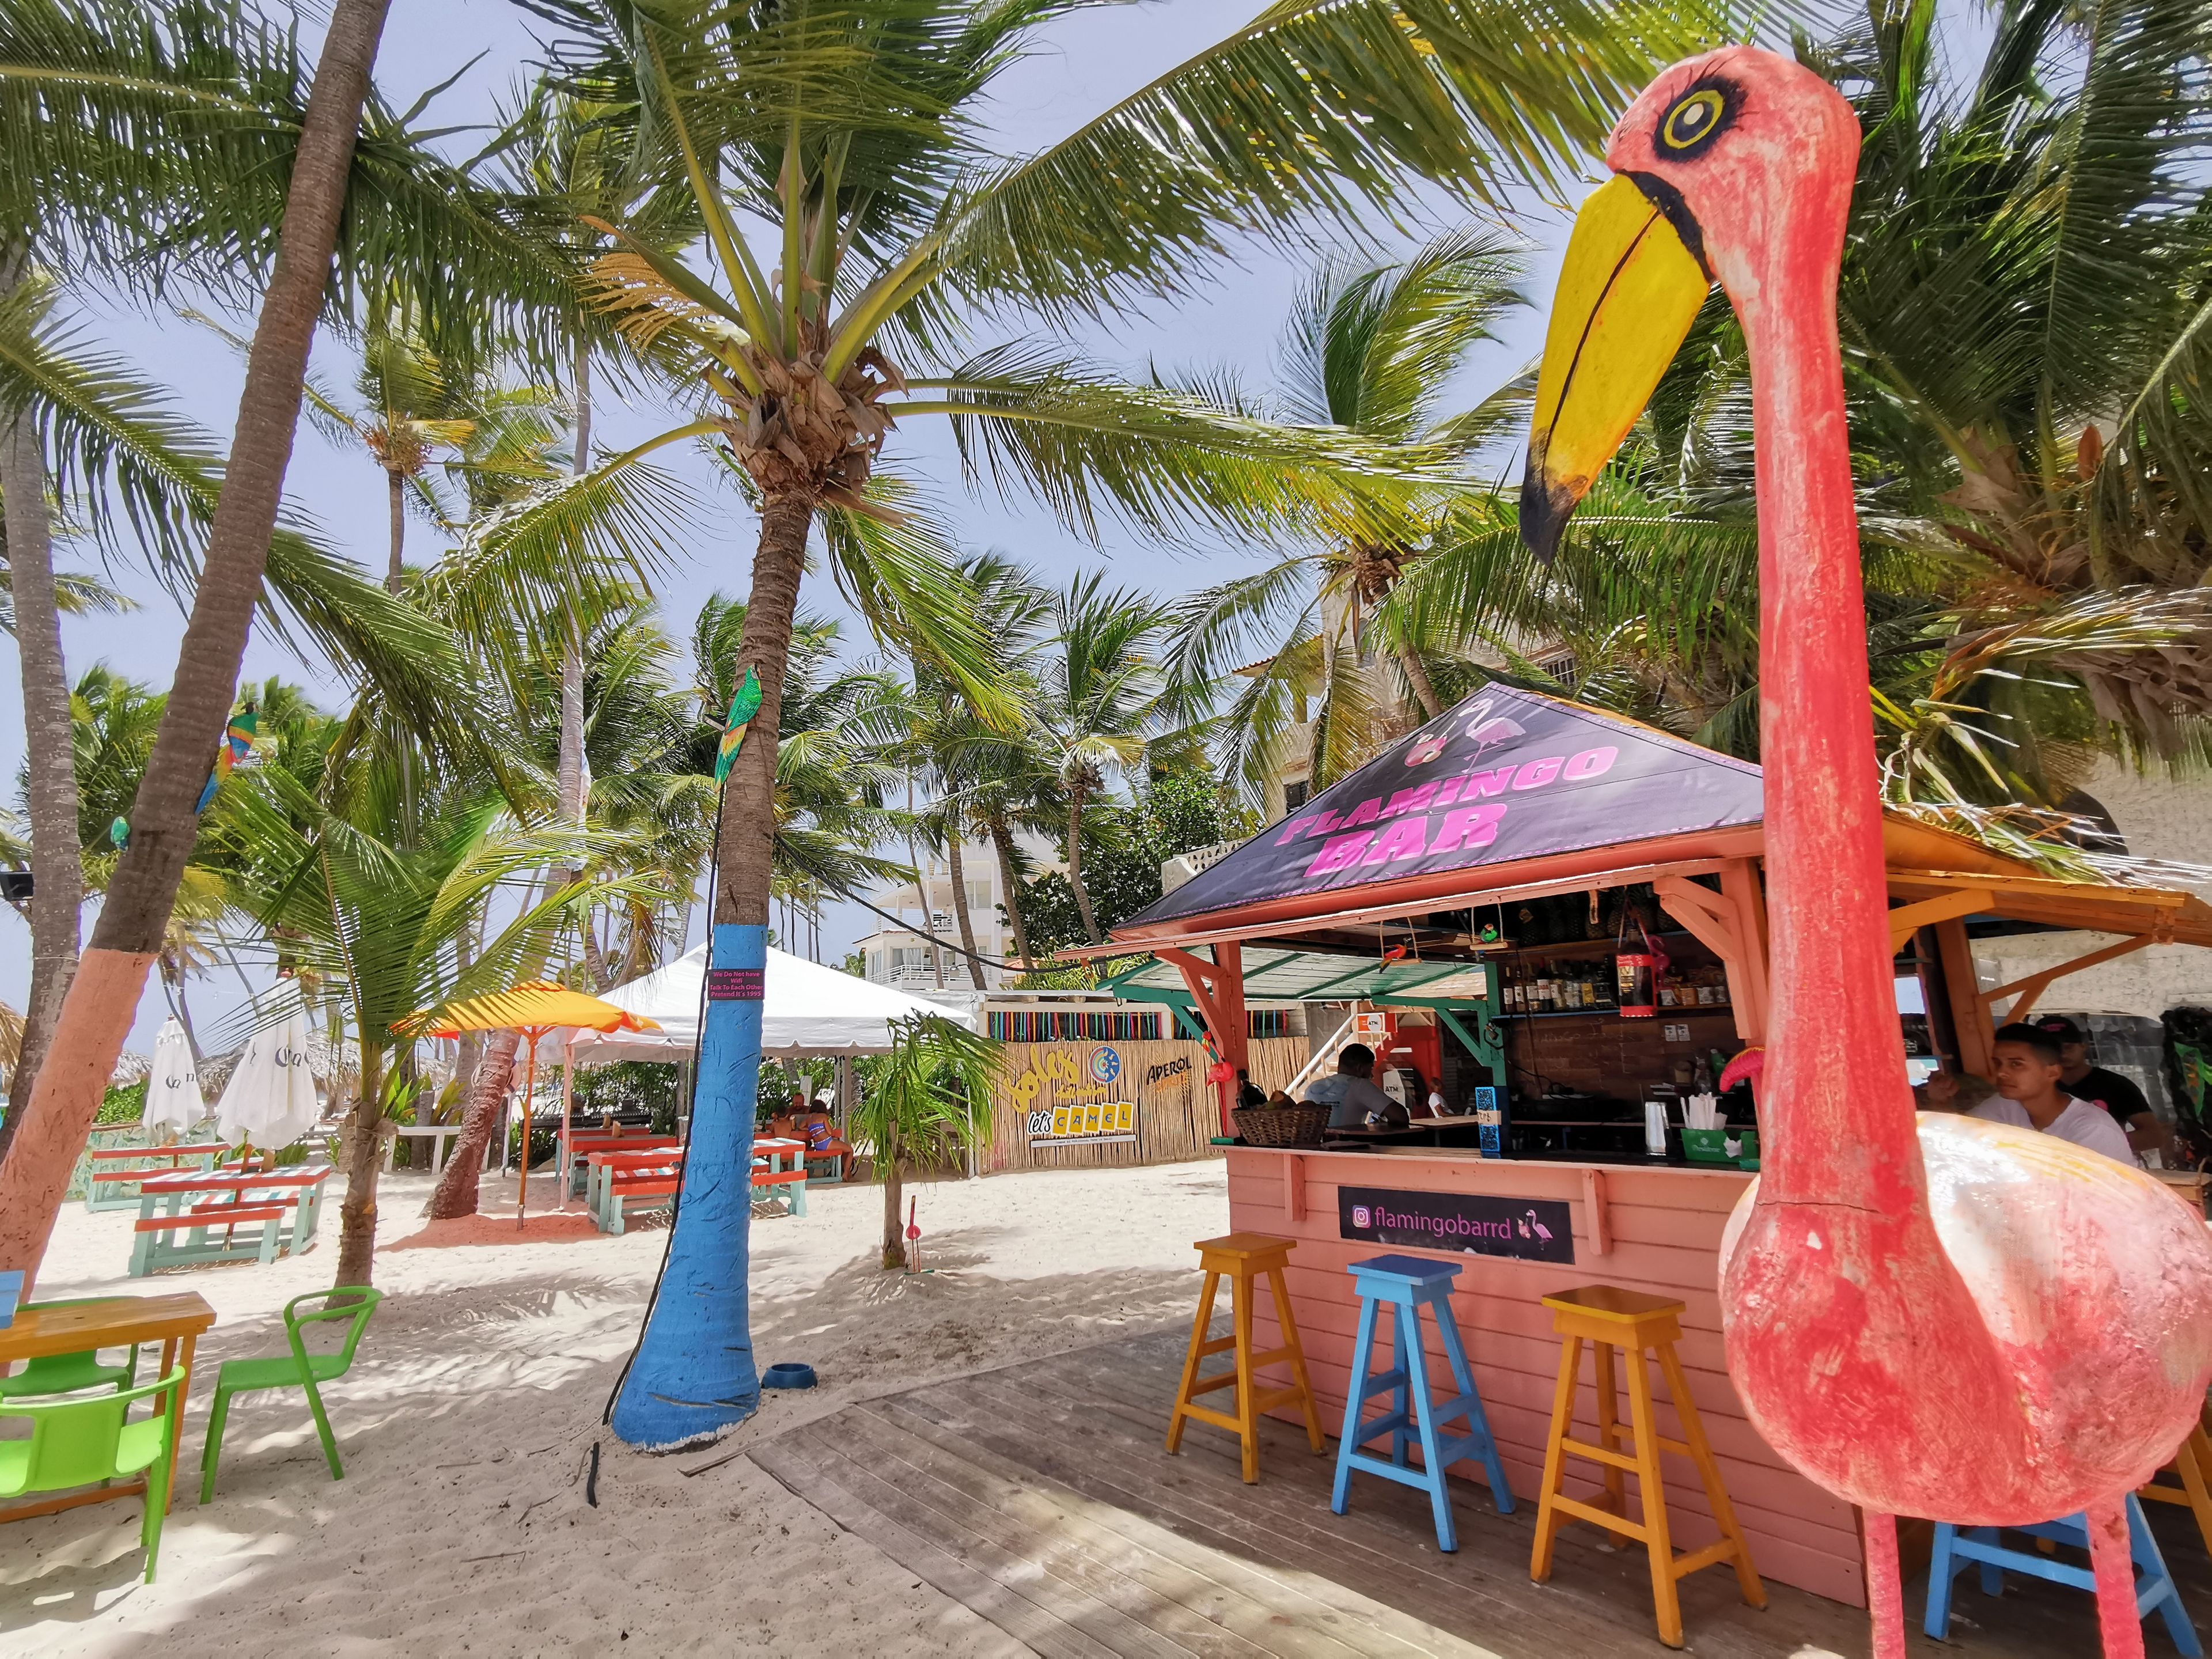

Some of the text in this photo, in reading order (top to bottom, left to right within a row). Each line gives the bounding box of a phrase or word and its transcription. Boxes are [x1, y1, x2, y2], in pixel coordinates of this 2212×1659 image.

[1274, 747, 1619, 847] FLAMINGO
[1303, 803, 1508, 877] BAR
[1146, 1055, 1192, 1085] APEROL
[1028, 1110, 1128, 1134] let's CAMEL
[1374, 1205, 1512, 1240] flamingobarrd
